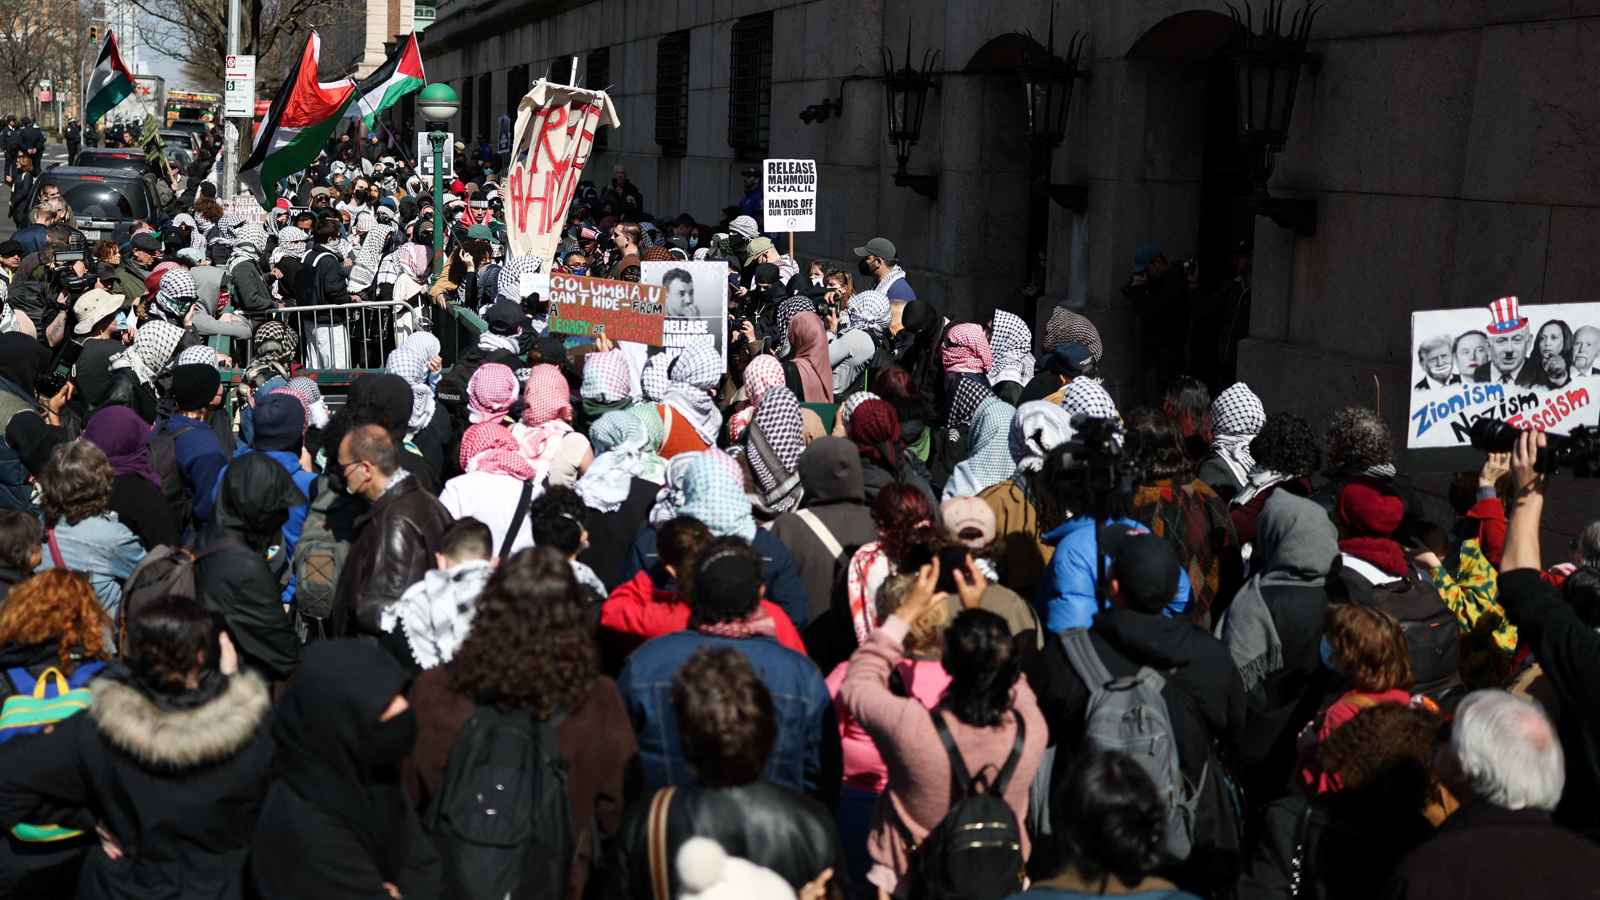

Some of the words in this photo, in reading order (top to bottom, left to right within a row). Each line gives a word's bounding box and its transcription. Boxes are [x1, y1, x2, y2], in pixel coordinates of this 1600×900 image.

[768, 162, 814, 174] RELEASE
[768, 175, 815, 184] MAHMOUD
[768, 199, 798, 208] HANDS
[800, 199, 813, 207] OFF
[549, 290, 590, 306] CAN'T
[592, 296, 619, 310] HIDE
[632, 301, 662, 314] FROM
[550, 303, 558, 316] A
[664, 320, 708, 334] RELEASE
[1412, 383, 1505, 437] Zionism
